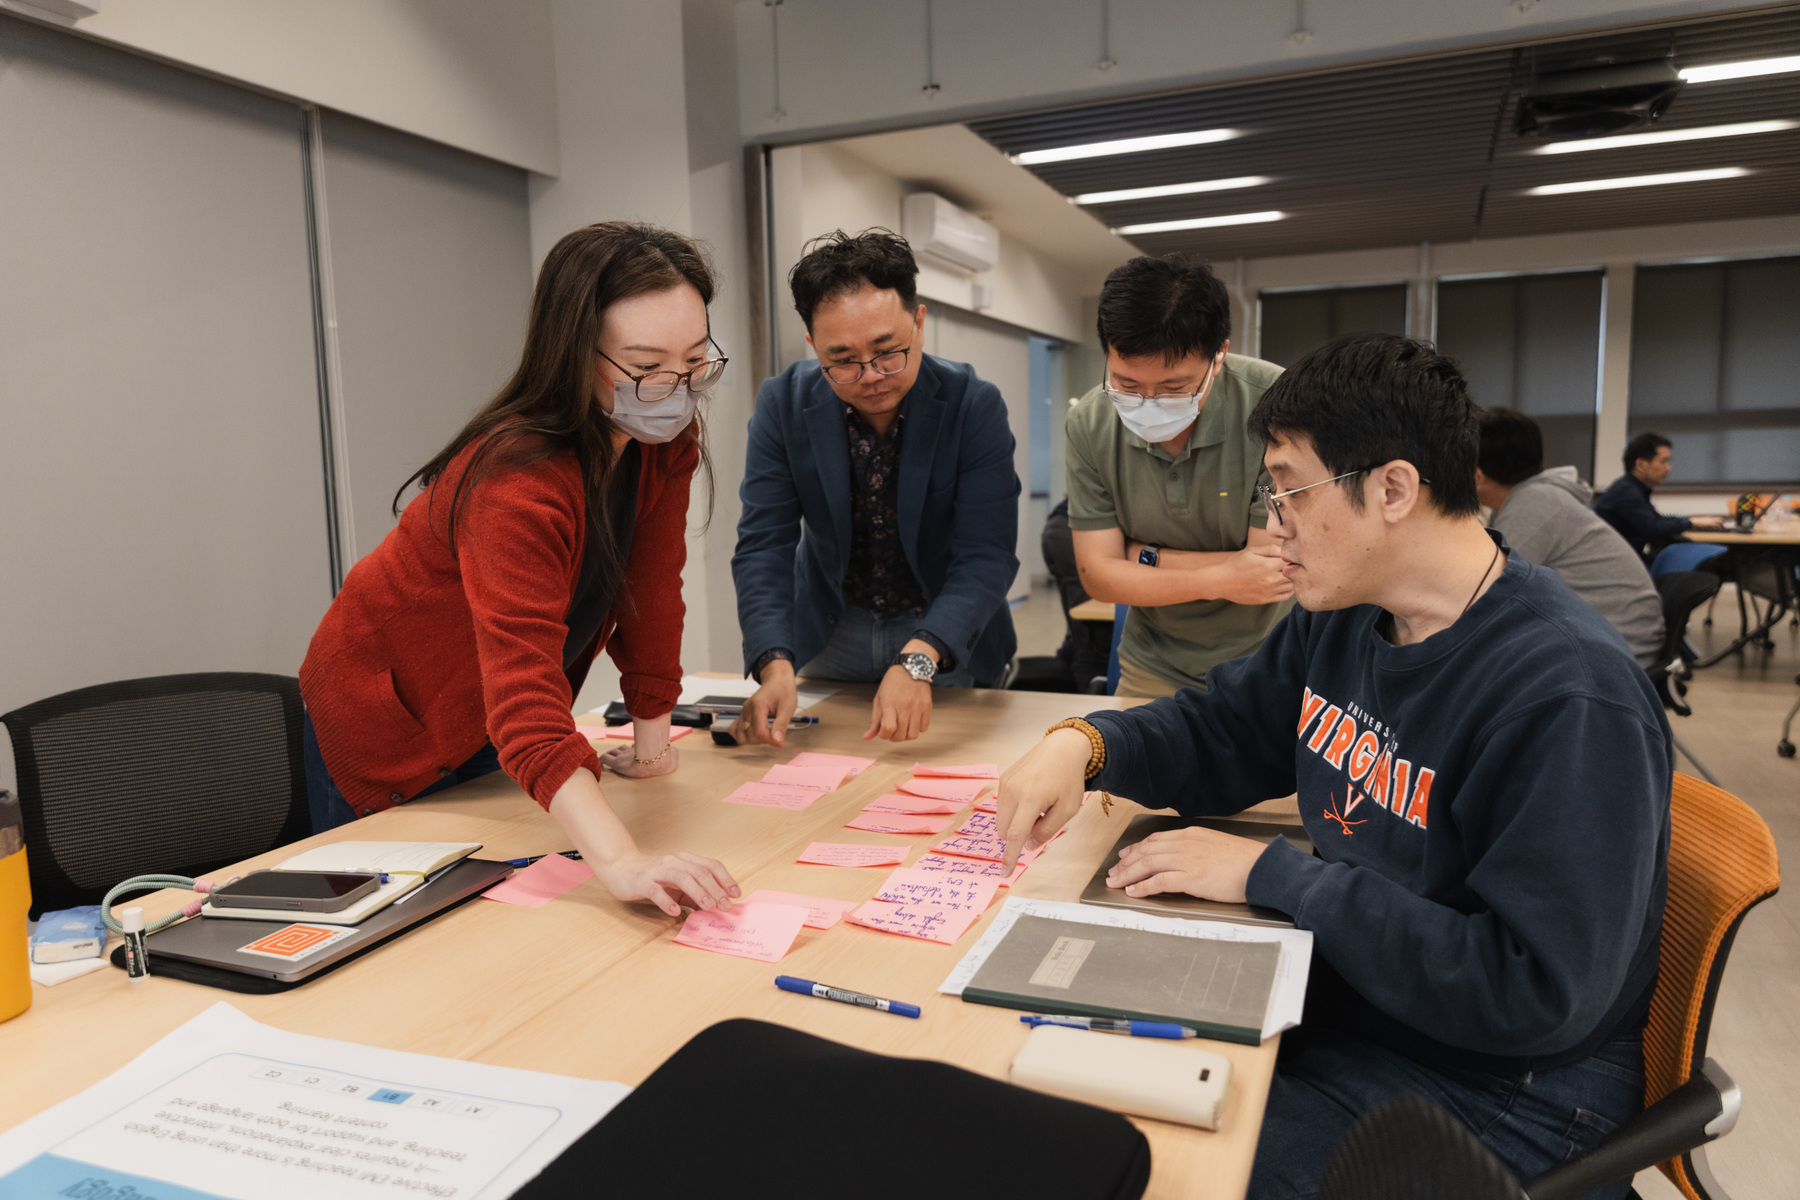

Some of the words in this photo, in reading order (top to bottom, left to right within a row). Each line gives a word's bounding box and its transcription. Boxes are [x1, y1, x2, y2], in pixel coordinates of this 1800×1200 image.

[1347, 701, 1396, 738] UNIVERS
[1297, 686, 1436, 830] VIRGINIA
[265, 1070, 282, 1079] C2
[303, 1076, 320, 1085] C1
[342, 1084, 360, 1093] B2
[167, 1097, 195, 1109] and
[422, 1098, 440, 1107] A2
[466, 1105, 482, 1114] A1
[197, 1101, 254, 1122] language
[277, 1101, 332, 1125] learning
[154, 1110, 225, 1132] interactive
[256, 1112, 290, 1130] both
[289, 1119, 312, 1134] for
[334, 1115, 389, 1131] content
[124, 1121, 172, 1140] English
[170, 1130, 208, 1147] using
[311, 1127, 369, 1147] support
[208, 1138, 242, 1154] than
[315, 1142, 353, 1157] clear
[371, 1134, 399, 1148] and
[242, 1146, 281, 1163] more
[356, 1149, 410, 1170] requires
[292, 1155, 359, 1180] teaching
[360, 1171, 391, 1186] EMI
[391, 1177, 458, 1199] Effective
